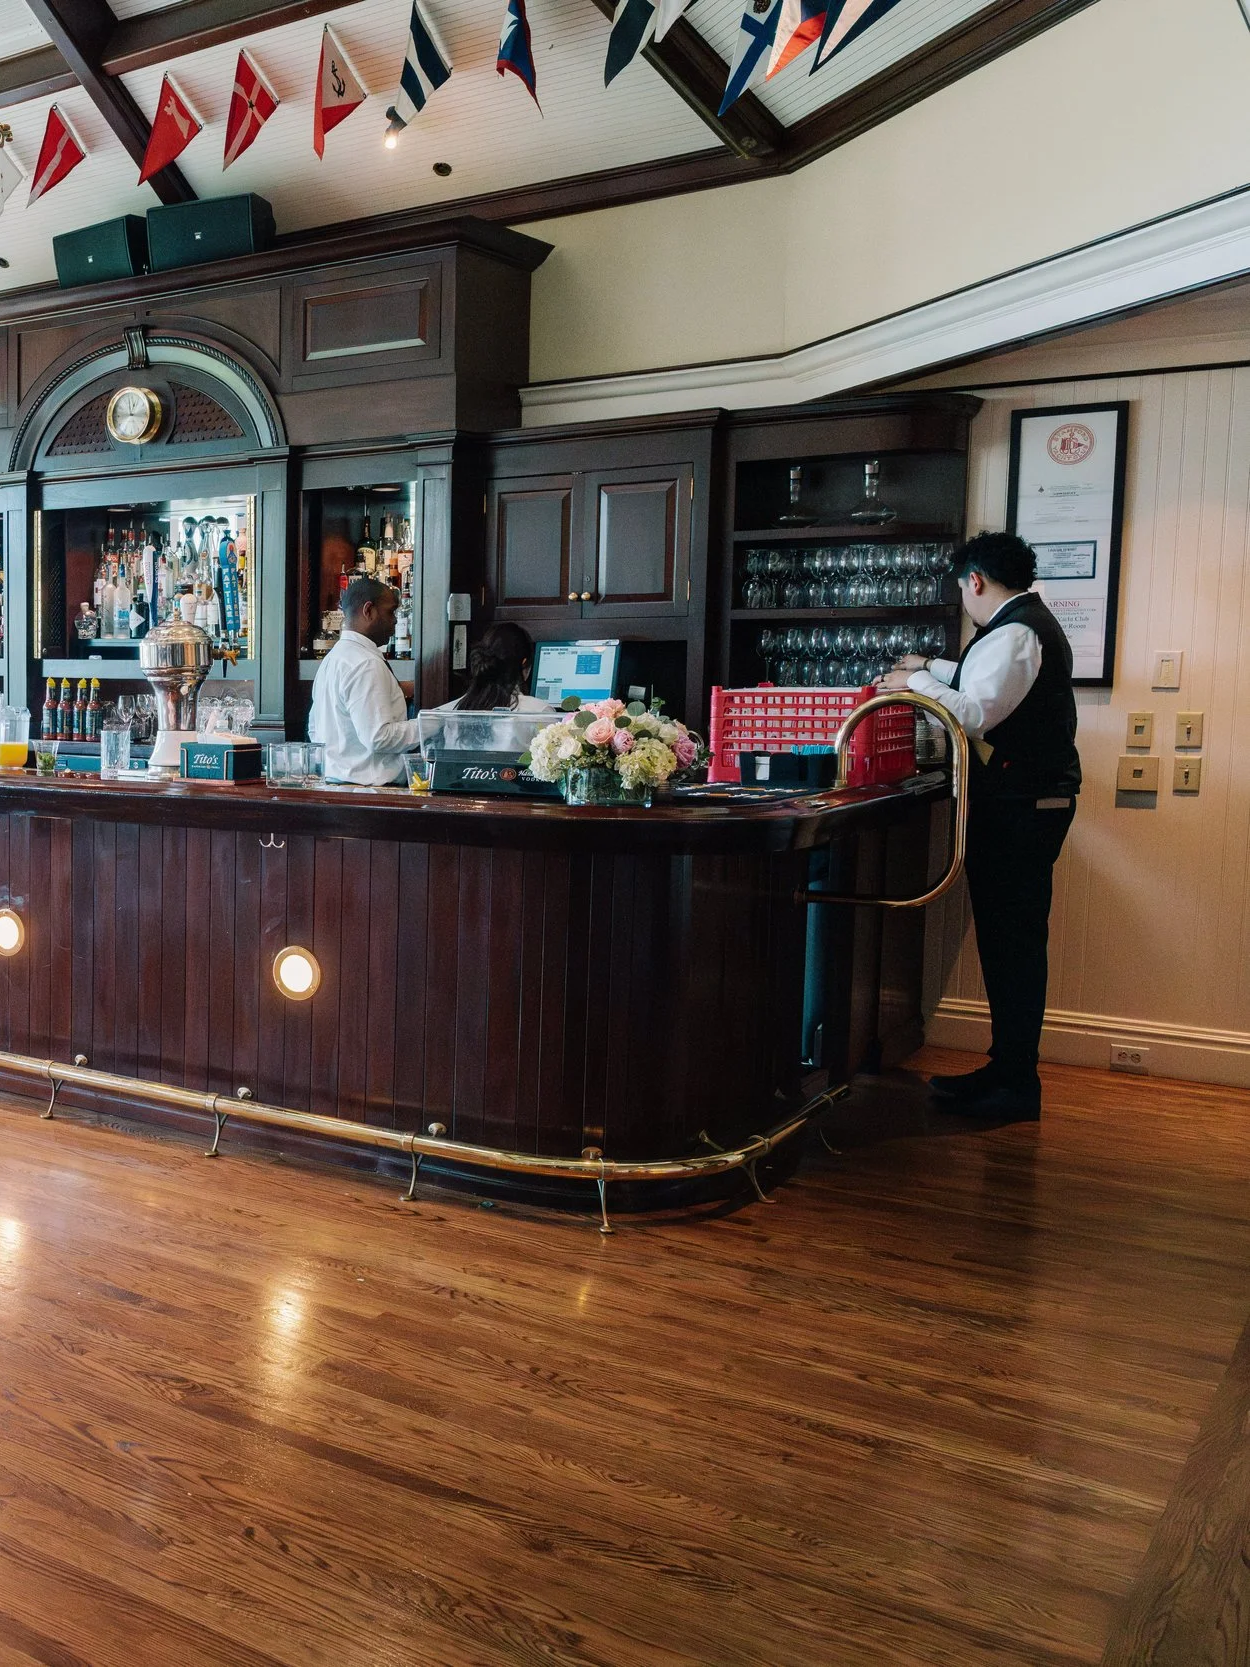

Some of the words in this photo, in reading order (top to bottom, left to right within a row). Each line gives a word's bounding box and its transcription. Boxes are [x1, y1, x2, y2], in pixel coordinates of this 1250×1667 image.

[1053, 427, 1089, 442] STAMFORD
[222, 568, 230, 588] FAT
[224, 591, 233, 617] TIRE
[1045, 600, 1080, 608] ARNING
[193, 753, 218, 764] Tito's
[462, 766, 498, 780] Tito's
